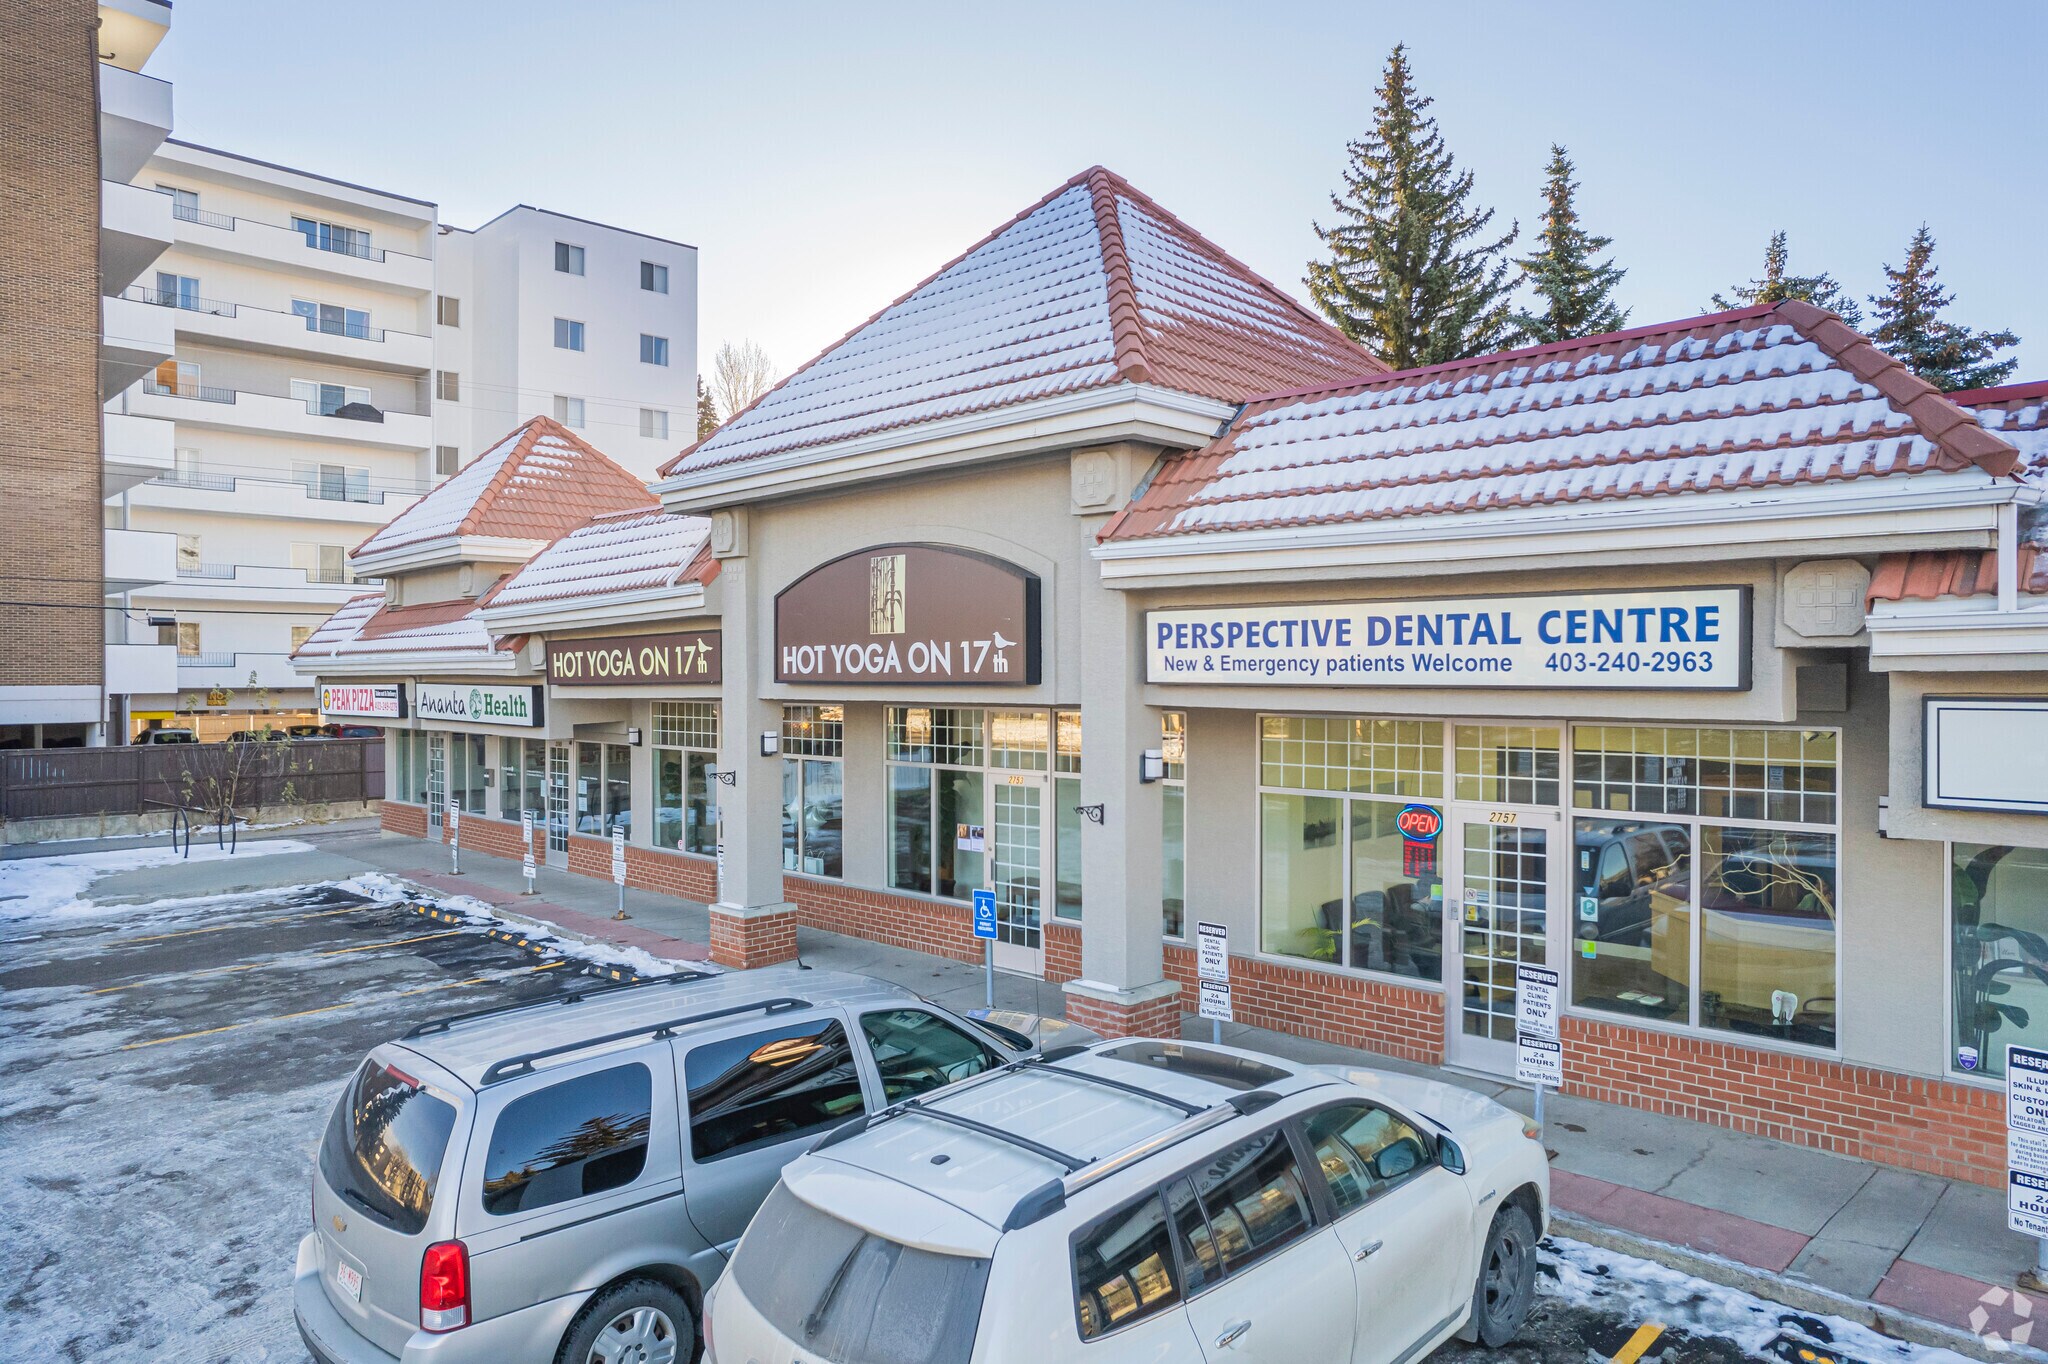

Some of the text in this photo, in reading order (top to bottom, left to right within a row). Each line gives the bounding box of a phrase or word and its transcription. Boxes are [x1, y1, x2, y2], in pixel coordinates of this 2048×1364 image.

[1157, 605, 1720, 649] PERSPECTIVE DENTAL CENTRE
[553, 651, 583, 678] HOT
[586, 647, 636, 677] YOGA
[639, 645, 669, 676] ON
[783, 644, 826, 675] HOT
[830, 640, 902, 675] YOGA
[907, 639, 951, 676] ON
[1164, 651, 1713, 676] New & Emergency patients Welcome 403-240-2963
[331, 688, 375, 712] PEAK PIZZA
[420, 690, 528, 718] Ananta Health
[1008, 775, 1024, 785] 2753
[1399, 812, 1438, 833] OPEN
[1489, 811, 1517, 824] 2757
[1199, 924, 1226, 936] RESERVED
[1204, 938, 1220, 946] DENTAL
[1205, 944, 1220, 952] CLINIC
[1202, 950, 1223, 958] PATIENTS
[1204, 957, 1220, 966] ONLY
[1520, 968, 1557, 983] RESERVED
[1202, 982, 1227, 992] RESERVED
[1526, 984, 1549, 994] DENTAL
[1527, 992, 1548, 1001] CLINIC
[1204, 998, 1226, 1006] HOURS
[1523, 999, 1552, 1010] PATIENTS
[1218, 1011, 1231, 1019] Parking
[1526, 1007, 1547, 1018] ONLY
[1522, 1038, 1558, 1050] RESERVED
[1523, 1057, 1555, 1066] HOURS
[1526, 1071, 1541, 1079] Tenant
[1542, 1073, 1559, 1083] Parking
[2013, 1082, 2032, 1091] SKIN
[2013, 1120, 2036, 1129] TAGGED
[2014, 1114, 2046, 1125] VIOLATORS
[2015, 1149, 2032, 1158] during
[2031, 1157, 2044, 1165] hours
[2014, 1217, 2023, 1227] No
